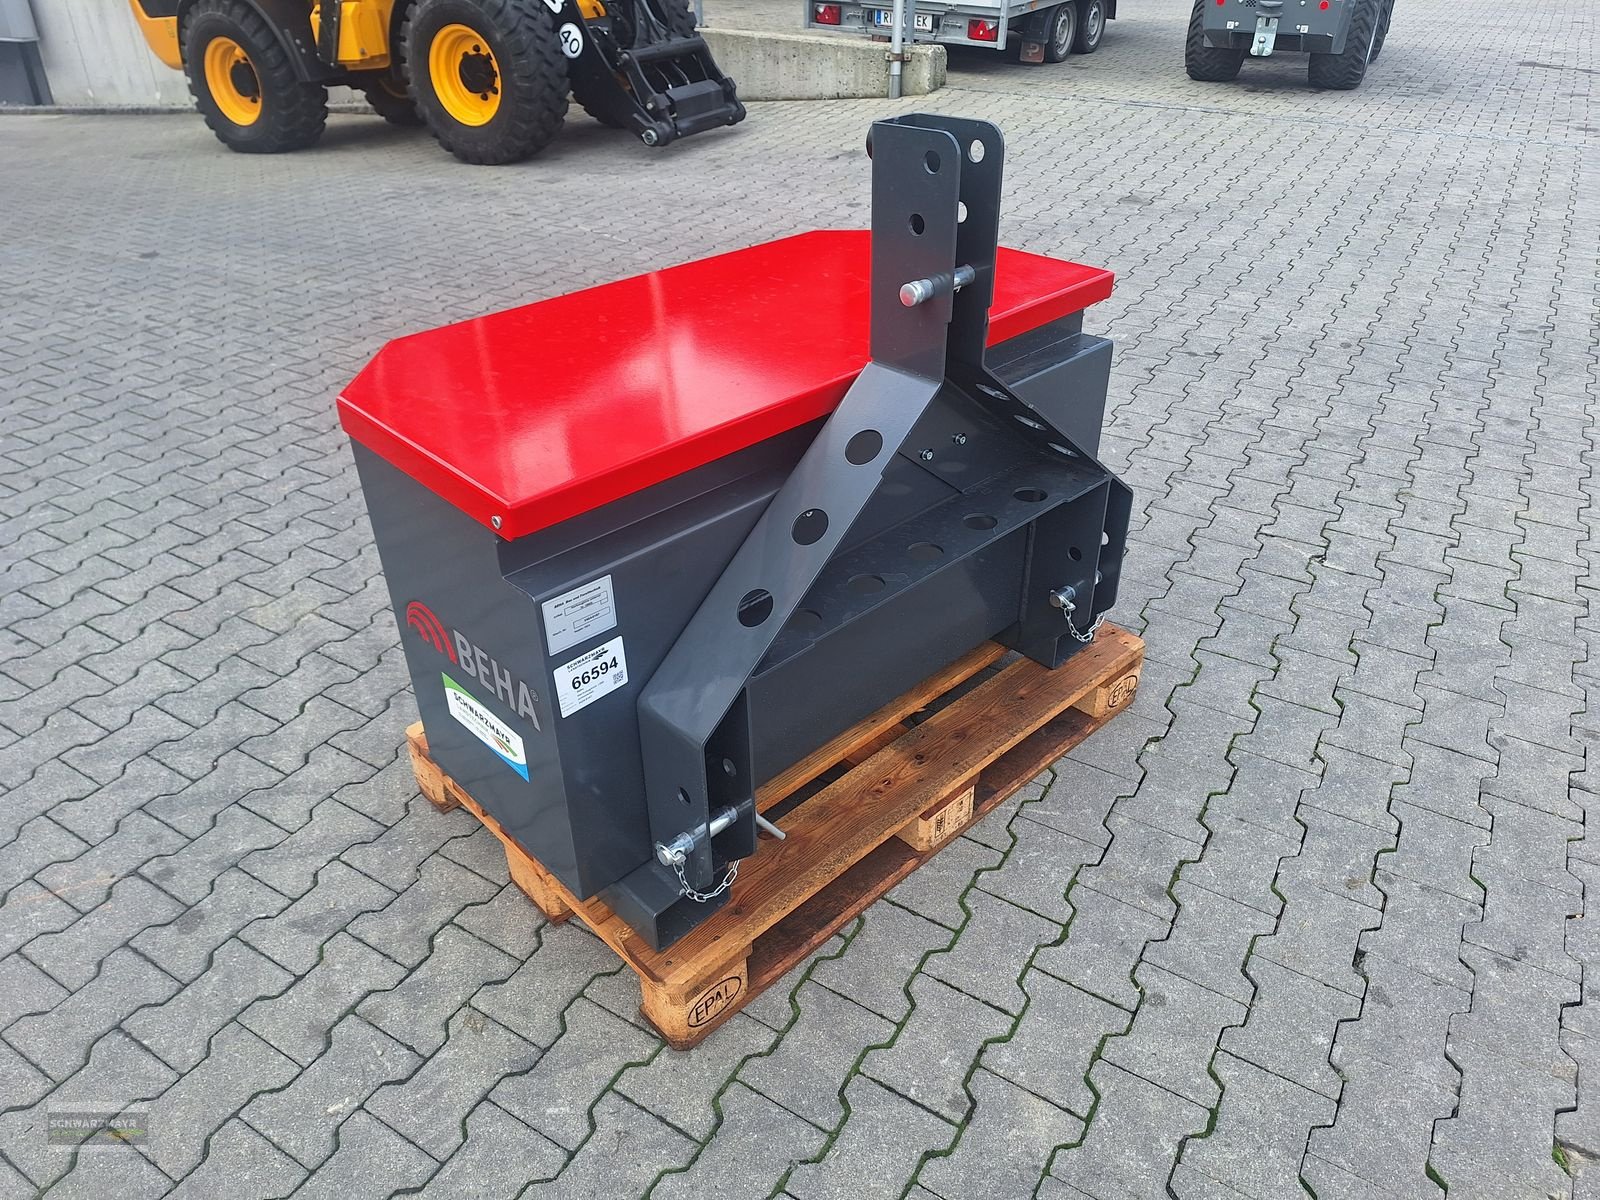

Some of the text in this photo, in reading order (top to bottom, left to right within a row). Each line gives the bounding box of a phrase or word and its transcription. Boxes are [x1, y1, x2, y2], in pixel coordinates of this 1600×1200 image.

[561, 30, 580, 55] 40
[571, 655, 619, 690] 66594
[694, 984, 734, 1024] EPAL
